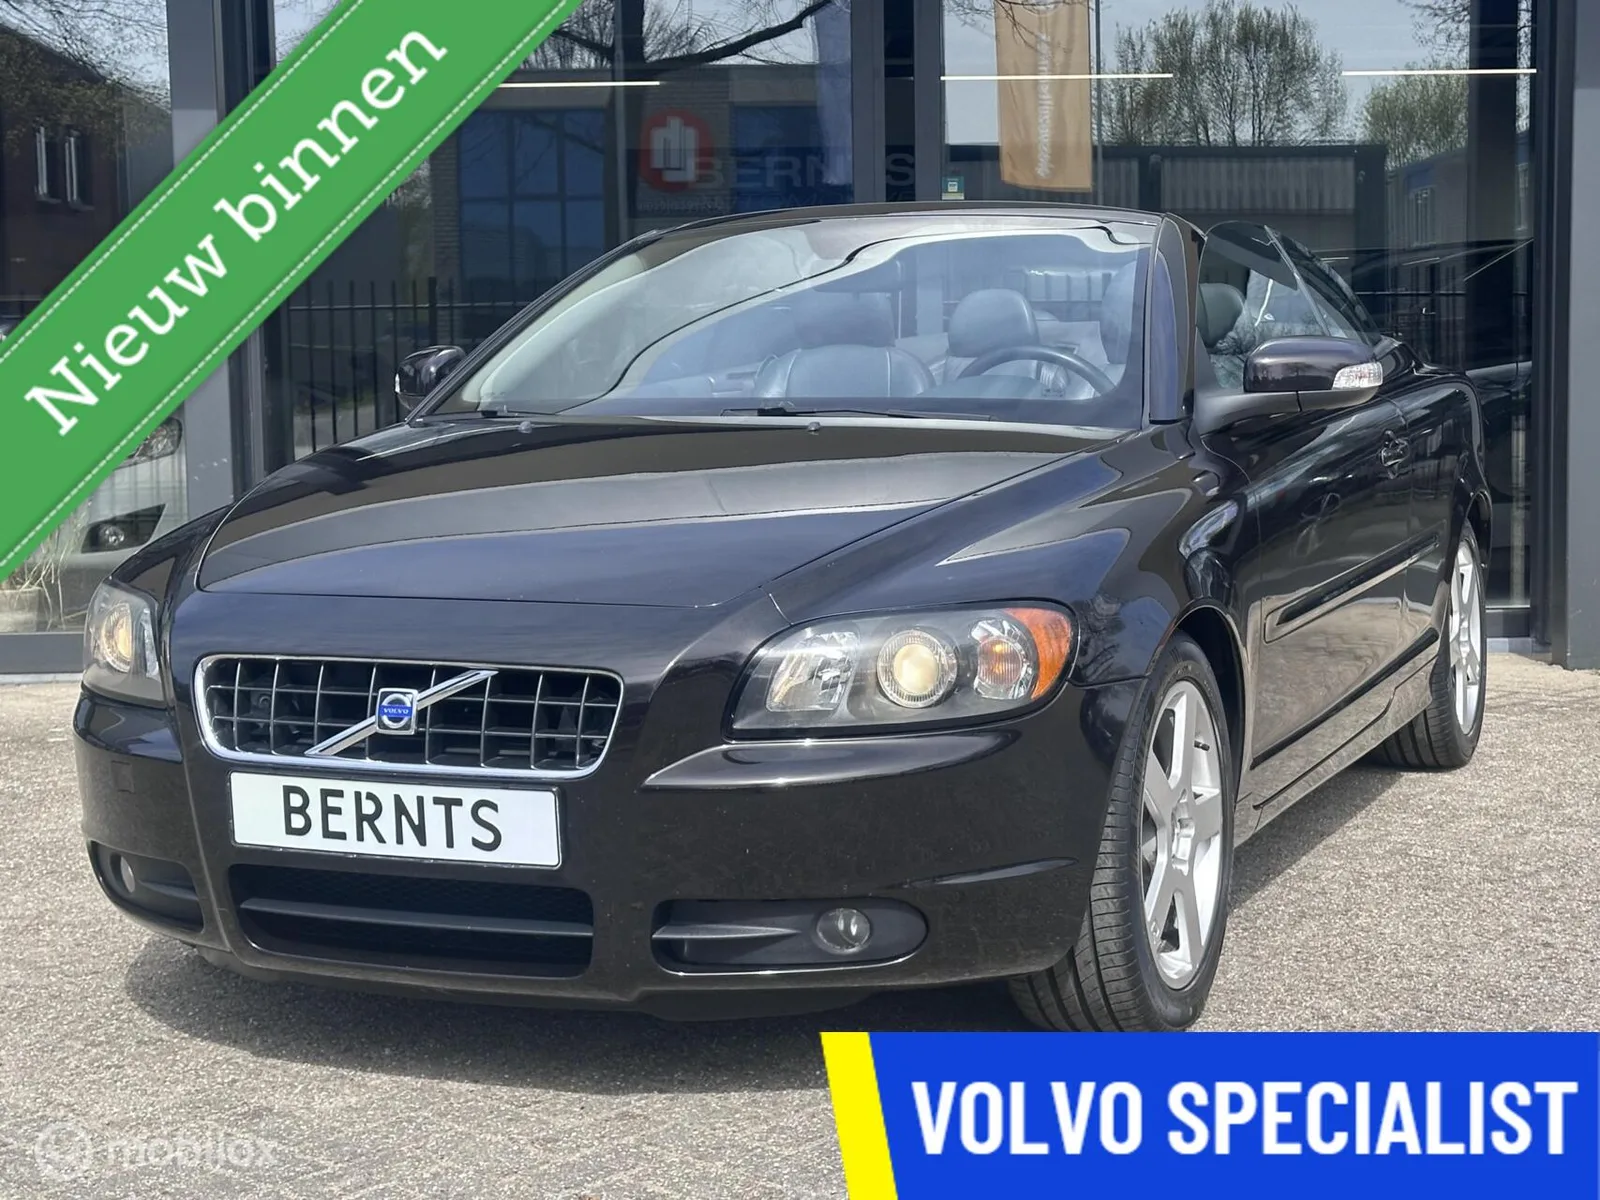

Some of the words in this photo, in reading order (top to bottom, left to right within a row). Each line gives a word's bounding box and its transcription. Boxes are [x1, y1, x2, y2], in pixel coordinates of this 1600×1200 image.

[692, 153, 915, 187] BERNS
[383, 707, 409, 715] VOLVO
[282, 784, 502, 852] BERNTS
